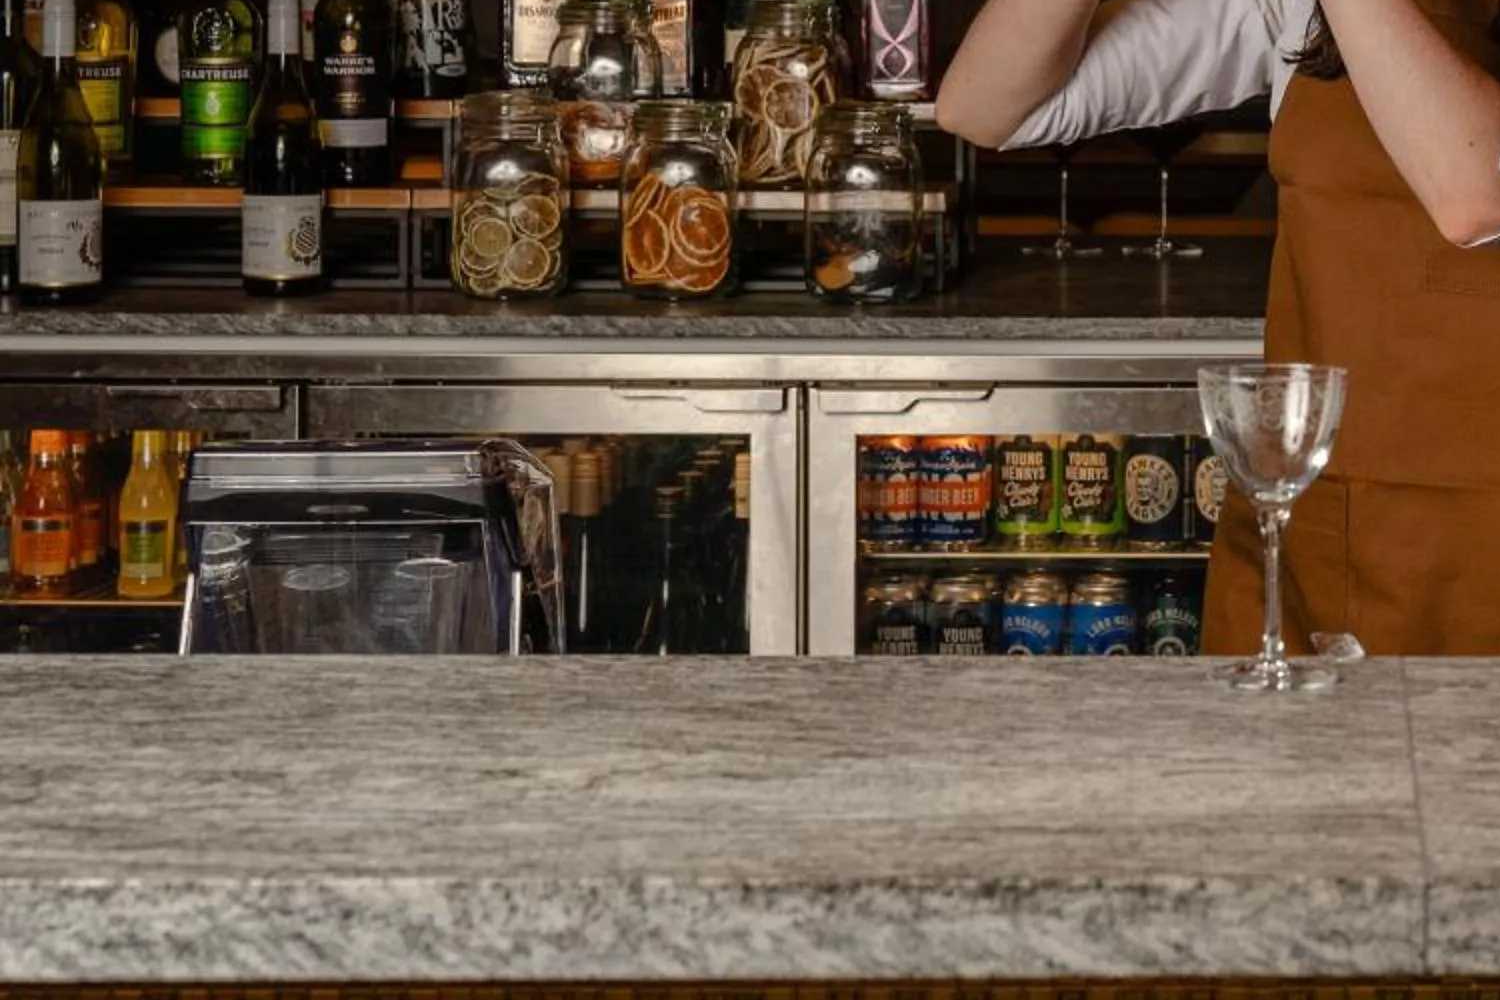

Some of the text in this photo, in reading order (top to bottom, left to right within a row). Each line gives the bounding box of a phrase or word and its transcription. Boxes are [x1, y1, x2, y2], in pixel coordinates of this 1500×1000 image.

[1004, 451, 1044, 466] YOUNG
[1068, 451, 1107, 466] YOUNG
[943, 626, 984, 642] YOUNG
